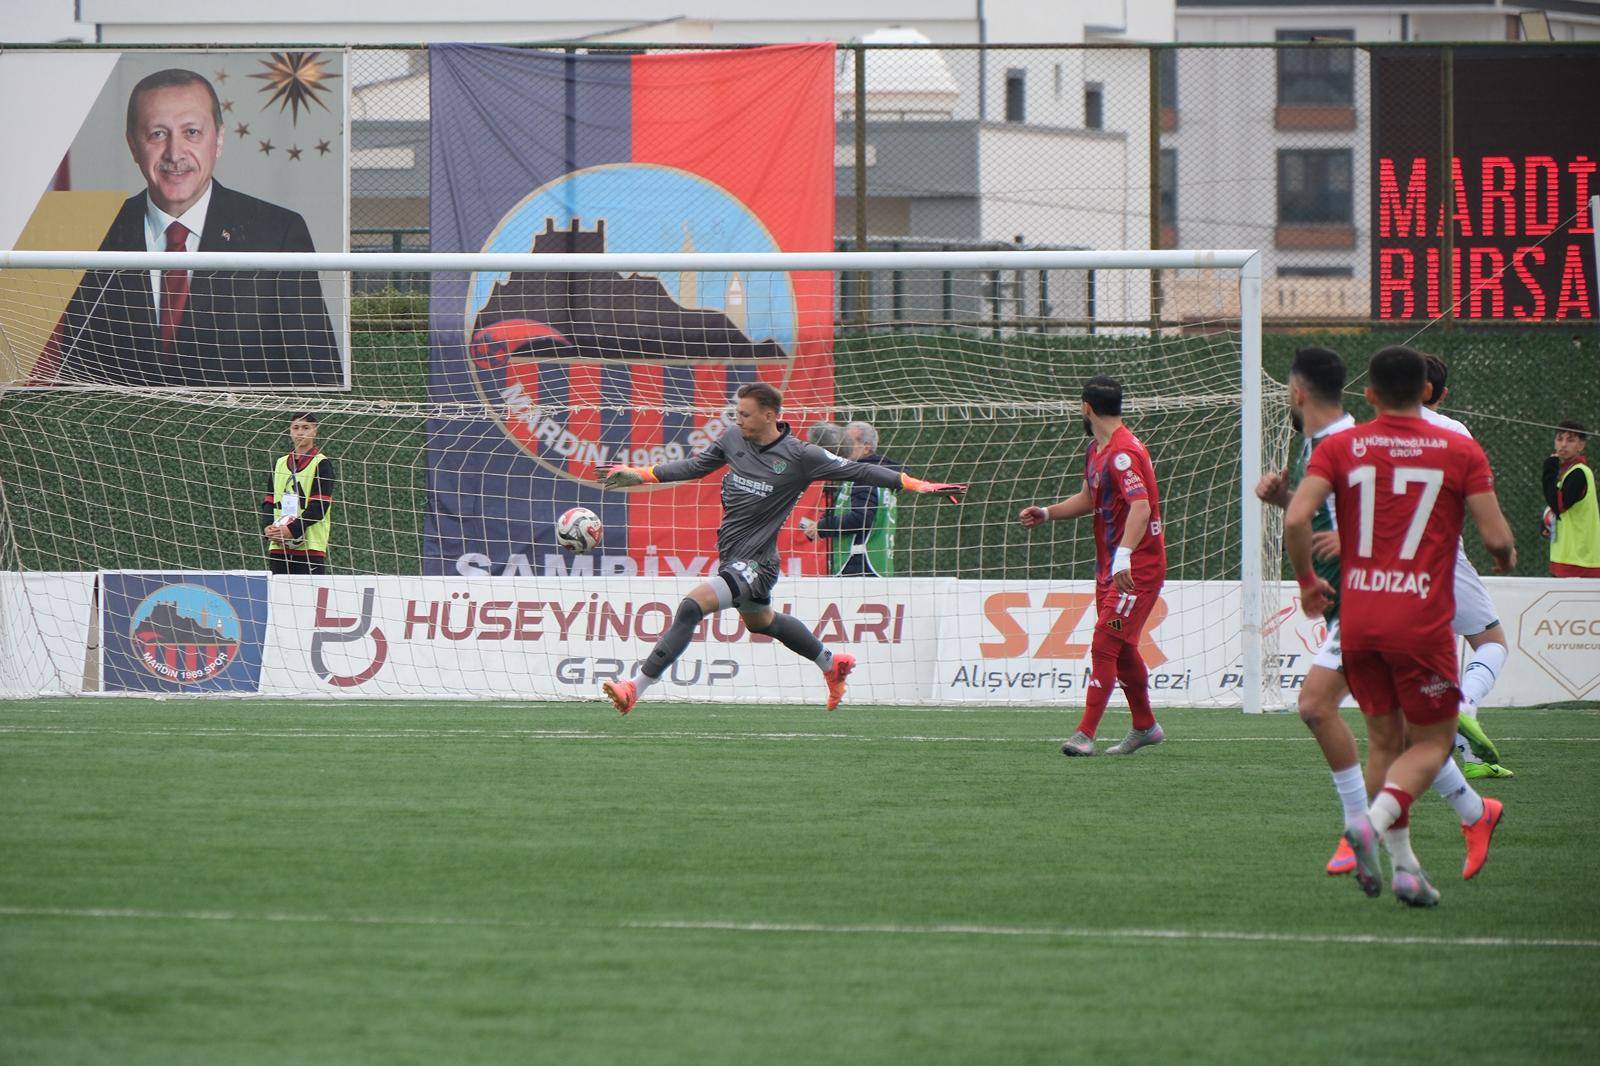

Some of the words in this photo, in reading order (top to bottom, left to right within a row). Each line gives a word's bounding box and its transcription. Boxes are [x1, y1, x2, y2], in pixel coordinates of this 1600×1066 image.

[1379, 245, 1593, 322] BURSA
[616, 442, 684, 468] 1969
[687, 386, 740, 454] SPO
[1389, 448, 1423, 458] GROUP
[1347, 465, 1444, 560] 17
[1348, 568, 1431, 599] YILDIZAÇ
[404, 592, 905, 643] HÜSEYİNOUARI
[1115, 592, 1138, 618] 11
[180, 670, 203, 679] 1969
[204, 652, 228, 674] SPOR
[951, 664, 1073, 693] Alışveriş
